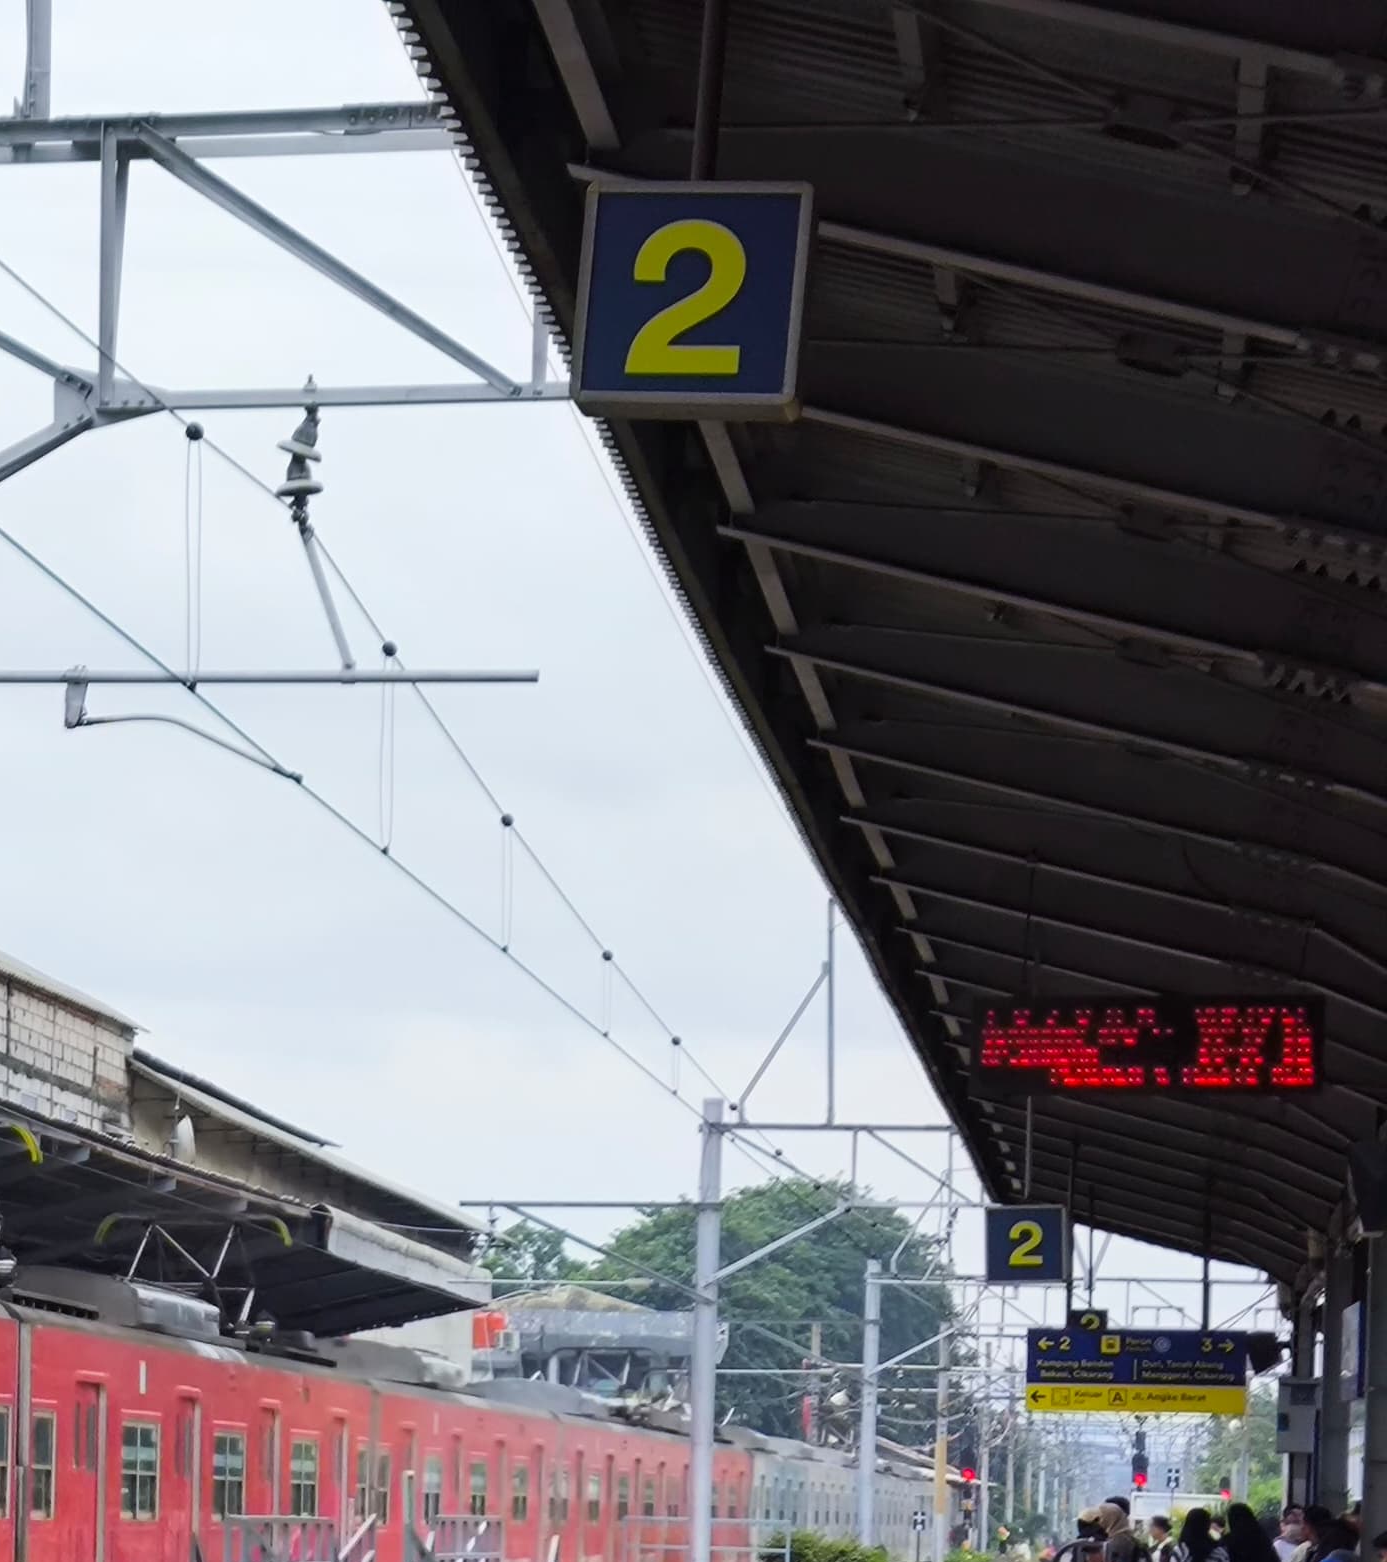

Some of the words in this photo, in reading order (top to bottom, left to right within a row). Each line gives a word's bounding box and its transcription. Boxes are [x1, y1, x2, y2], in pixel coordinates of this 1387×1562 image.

[624, 218, 747, 376] 2
[1008, 1220, 1044, 1266] 2
[1059, 1335, 1071, 1351] 2
[1201, 1337, 1213, 1352] 3
[1111, 1391, 1124, 1403] A
